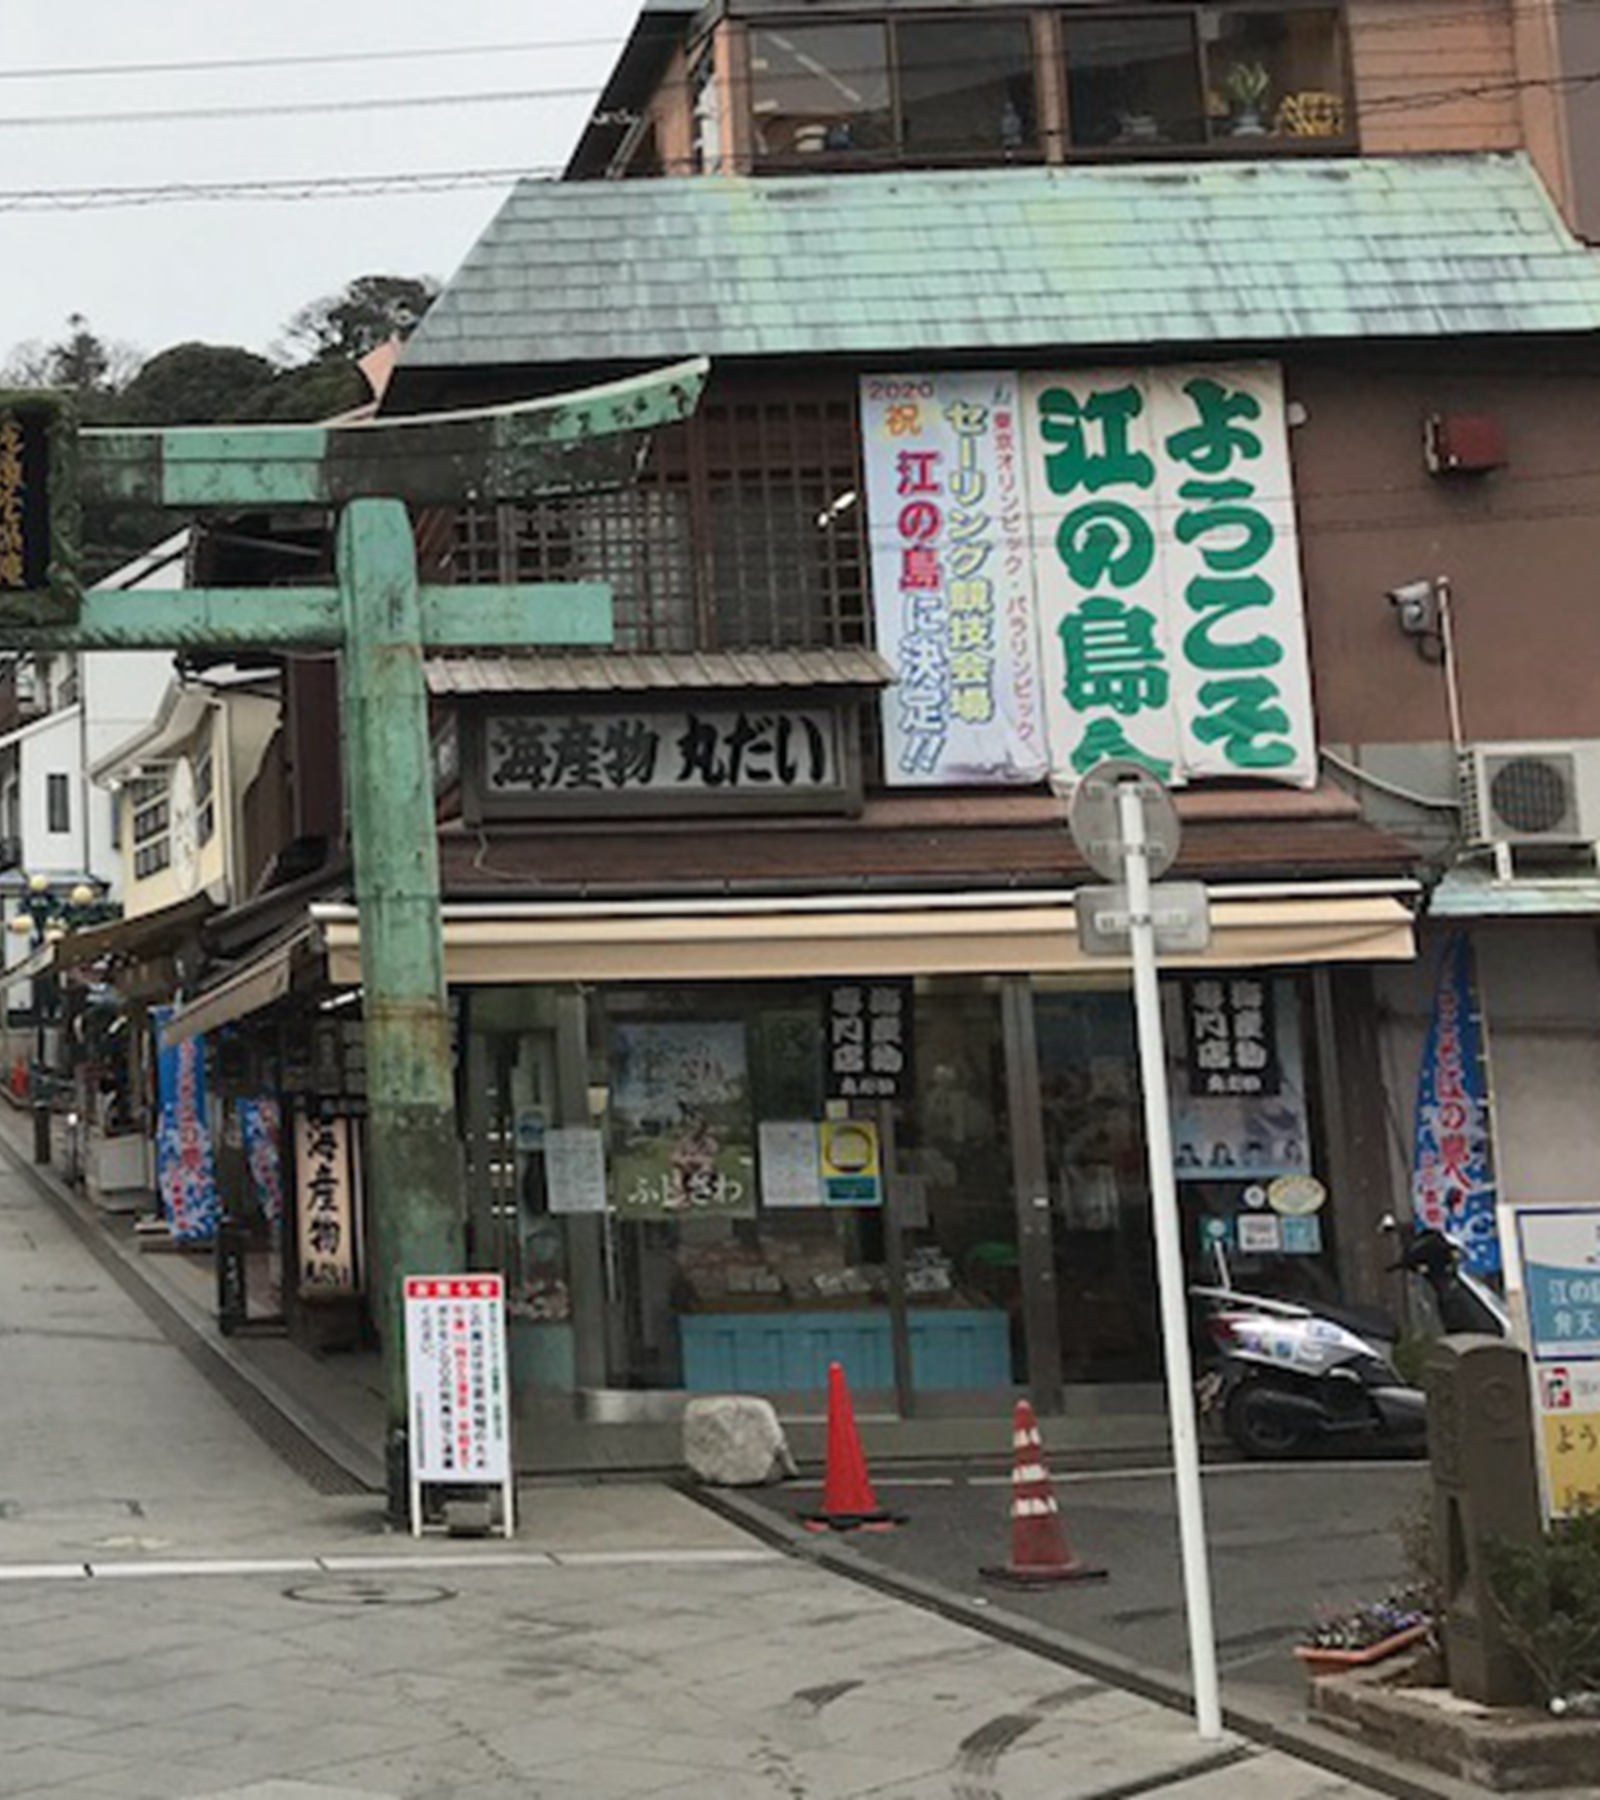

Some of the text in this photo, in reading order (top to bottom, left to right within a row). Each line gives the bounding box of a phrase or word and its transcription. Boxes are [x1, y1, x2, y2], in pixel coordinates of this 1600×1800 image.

[870, 381, 934, 399] 2020
[884, 403, 922, 436] 祝
[945, 400, 996, 724] セーリング競技会場
[1037, 384, 1173, 780] 江の島へ
[1166, 379, 1297, 769] ようこそ
[492, 712, 826, 788] 海産物 丸だい
